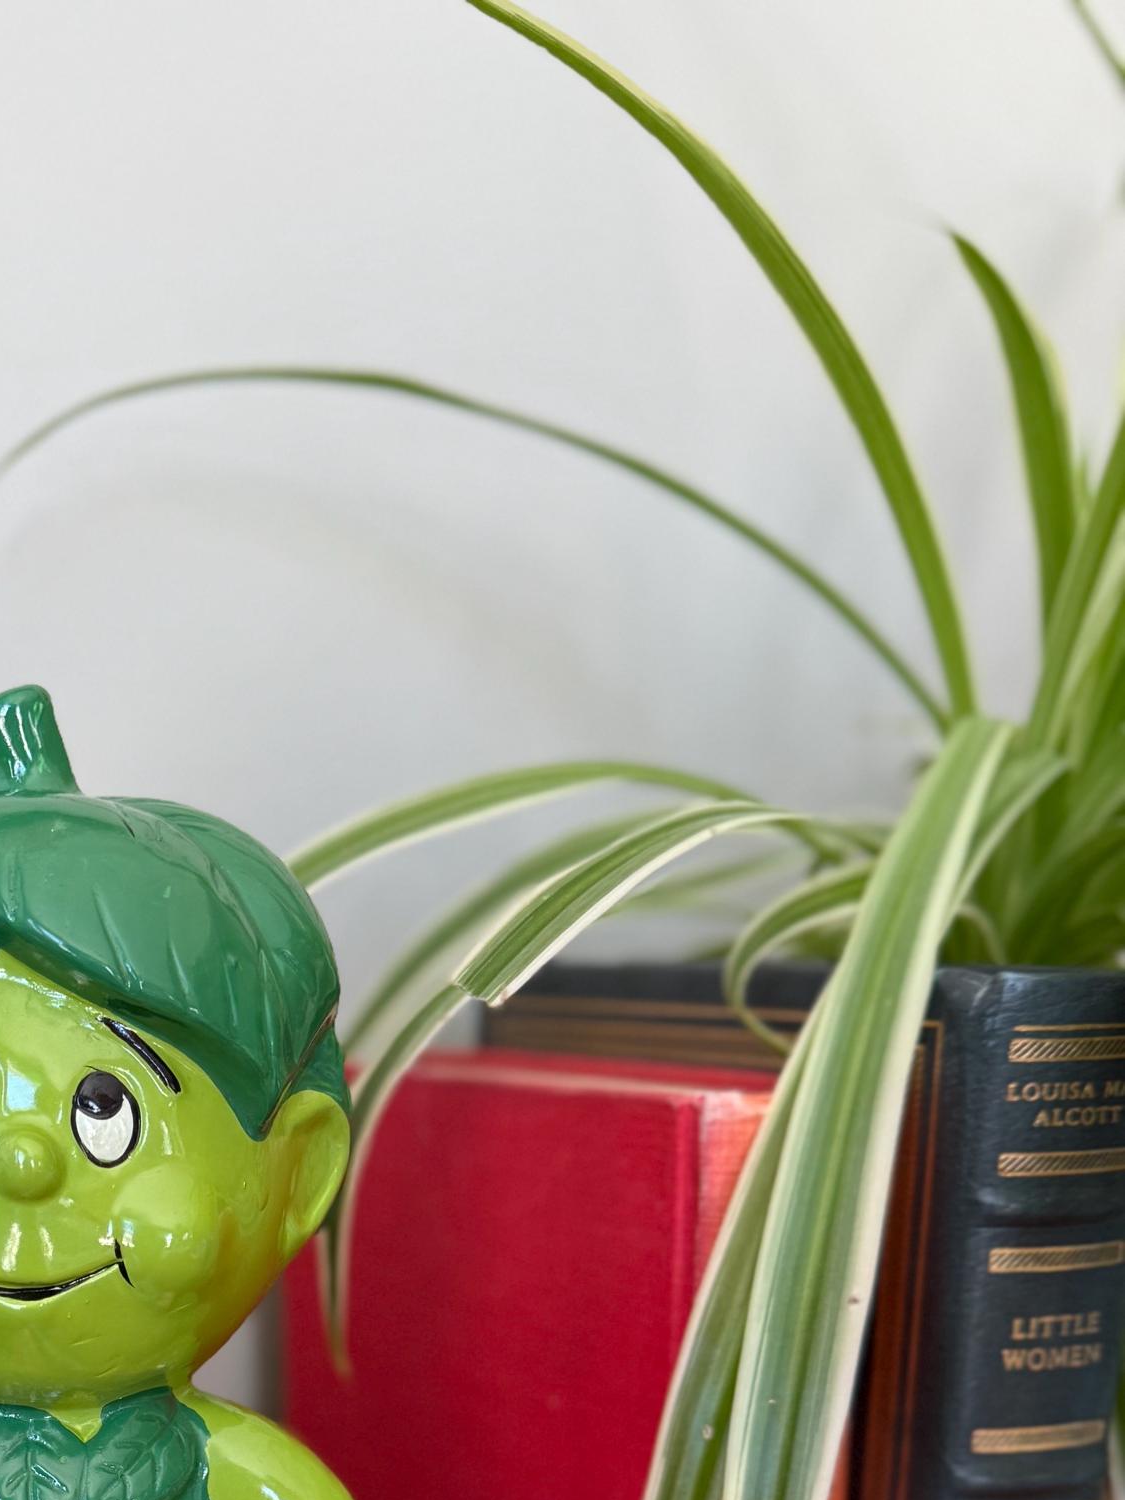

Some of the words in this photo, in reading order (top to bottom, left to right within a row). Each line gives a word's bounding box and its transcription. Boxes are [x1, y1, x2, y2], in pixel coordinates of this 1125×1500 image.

[1007, 1082, 1096, 1102] LOUISA
[1033, 1105, 1122, 1128] ALCOTT
[1011, 1311, 1101, 1341] LITTLE
[1001, 1344, 1101, 1372] WOMEN
